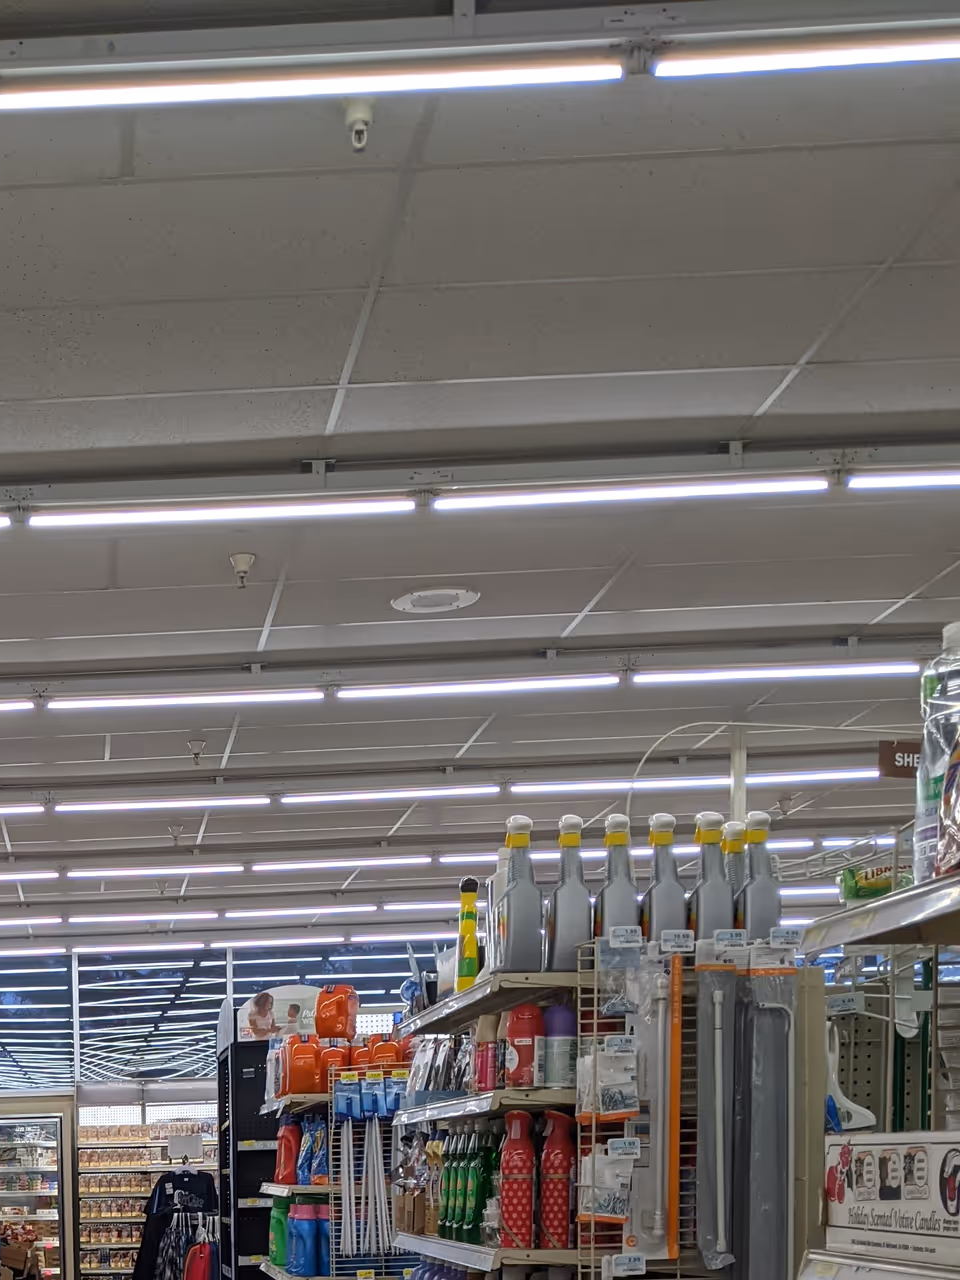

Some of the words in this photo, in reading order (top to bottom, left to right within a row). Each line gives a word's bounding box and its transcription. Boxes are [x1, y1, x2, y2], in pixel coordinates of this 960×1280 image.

[869, 1206, 893, 1229] Scented
[893, 1208, 914, 1229] Votive
[914, 1210, 942, 1232] Candles
